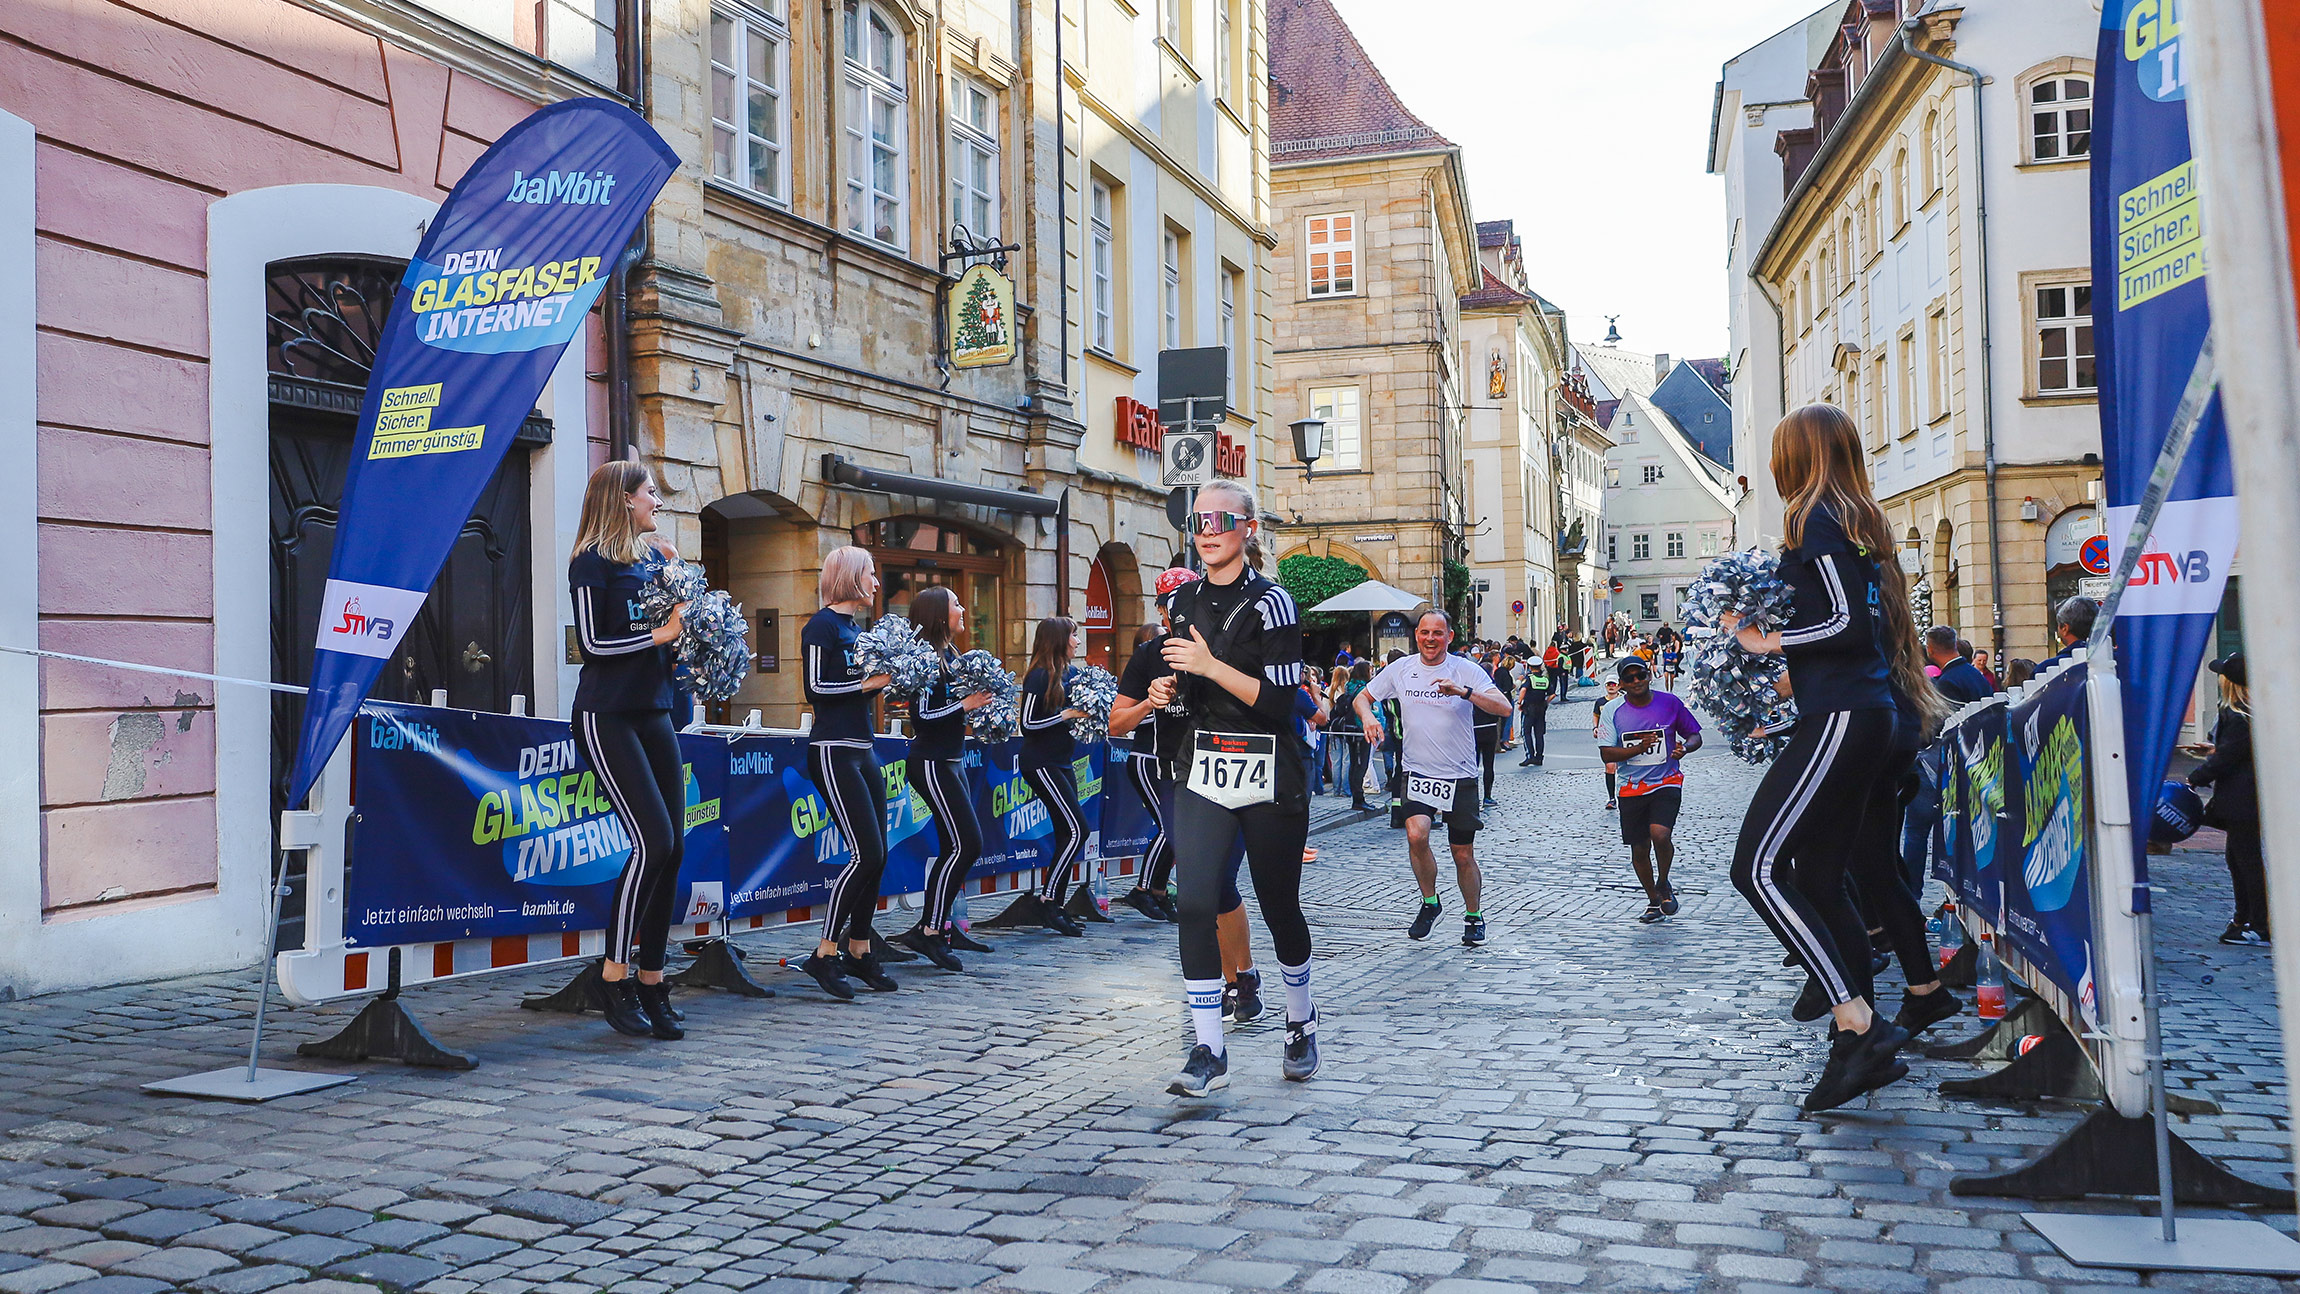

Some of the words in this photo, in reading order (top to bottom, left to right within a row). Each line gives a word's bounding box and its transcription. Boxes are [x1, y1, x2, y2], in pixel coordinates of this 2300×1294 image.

[506, 170, 616, 206] baMbit
[2124, 215, 2193, 262] Sicher.
[441, 247, 502, 276] DEIN
[2124, 252, 2196, 301] Immer
[411, 256, 601, 313] GLASFASER
[424, 294, 574, 342] INTERNET
[384, 387, 436, 408] Schnell.
[378, 413, 425, 432] Sicher.
[1114, 396, 1168, 454] Käth
[372, 439, 422, 455] Immer
[422, 430, 479, 452] günstig.
[1175, 473, 1200, 483] ZONE
[370, 717, 443, 755] baMbit
[1221, 739, 1249, 747] Sparkasse
[519, 740, 576, 780] DEIN
[730, 752, 774, 775] baMbit
[1199, 756, 1268, 789] 1674
[1411, 779, 1451, 800] 3363
[472, 770, 612, 845] GLASFA
[686, 803, 719, 827] günstig.
[513, 813, 632, 882] INTERN
[729, 888, 753, 905] Jetzt
[754, 884, 782, 901] einfach
[362, 907, 396, 926] Jetzt
[398, 904, 444, 923] einfach
[446, 902, 494, 920] wechseln
[521, 900, 575, 916] bambit.de
